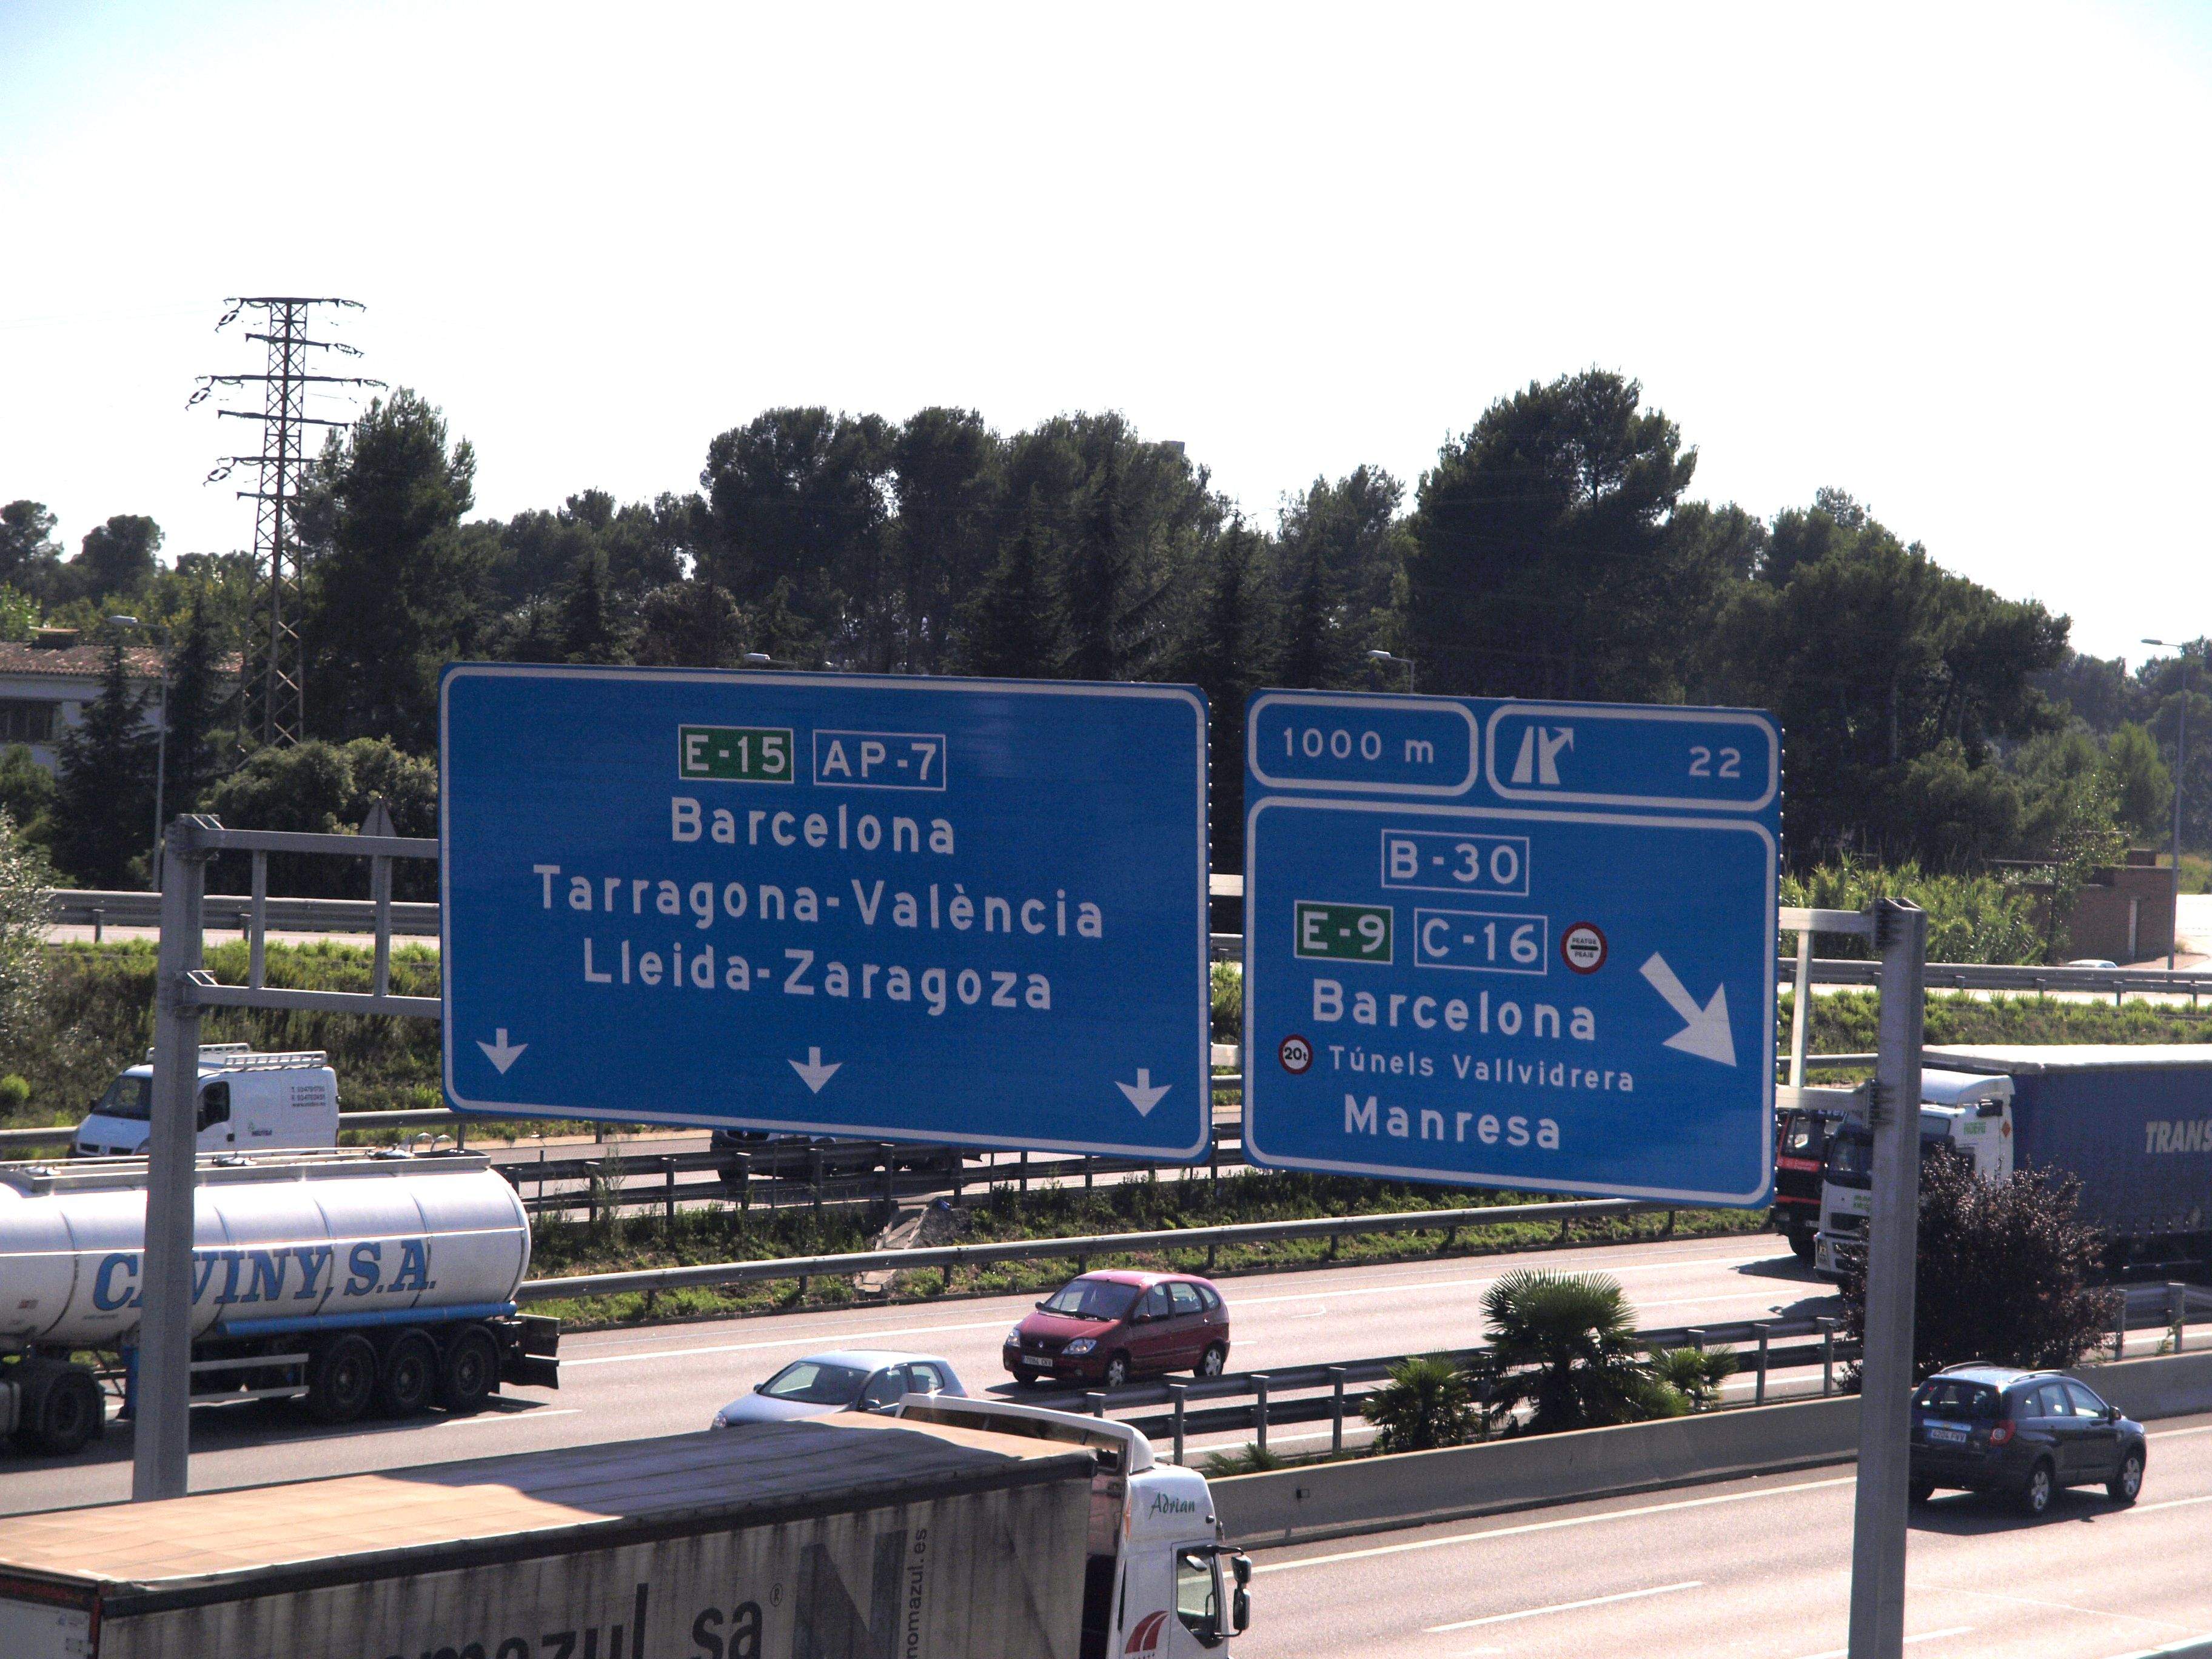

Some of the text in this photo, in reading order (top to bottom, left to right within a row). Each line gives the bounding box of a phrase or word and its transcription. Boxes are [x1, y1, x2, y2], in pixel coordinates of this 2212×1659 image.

[686, 734, 786, 774] E-15
[822, 740, 937, 780] AP-7
[1283, 727, 1434, 763] 1000 m
[1688, 745, 1741, 779] 22
[671, 796, 954, 855] Barcelona
[1390, 840, 1519, 885] B-30
[533, 864, 1102, 939] Tarragona-València
[1302, 911, 1386, 953] E-9
[1422, 917, 1538, 964] C-16
[584, 937, 1051, 1016] Lleida-Zaragoza
[1313, 978, 1595, 1041] Barcelona
[1329, 1045, 1634, 1091] Túnels Vallvidrera
[1344, 1094, 1560, 1150] Manresa
[93, 1246, 335, 1311] CVINY,
